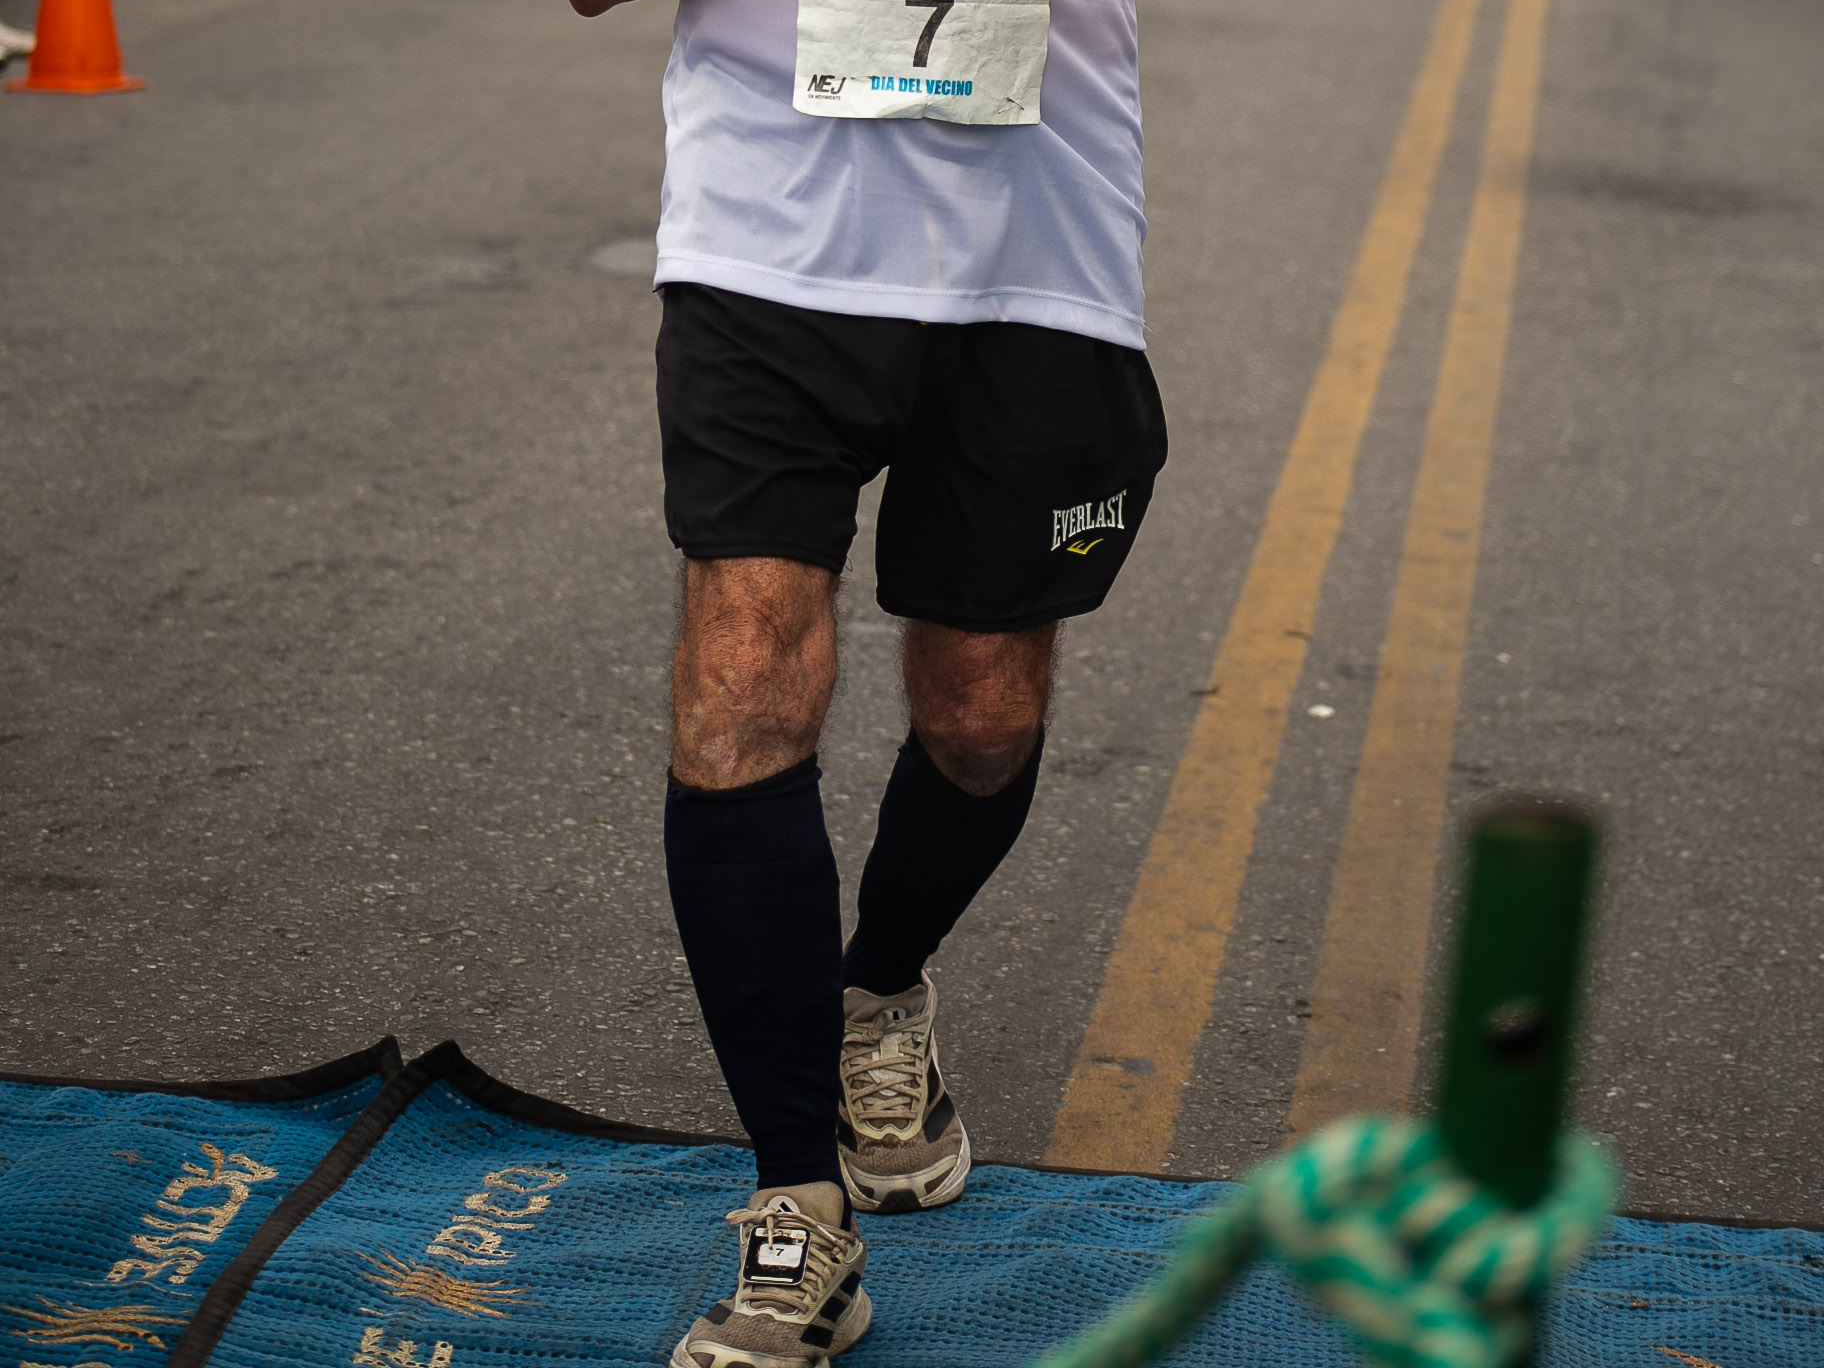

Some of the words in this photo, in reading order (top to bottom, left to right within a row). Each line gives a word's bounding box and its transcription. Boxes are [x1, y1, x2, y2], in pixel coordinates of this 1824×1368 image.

[807, 74, 846, 95] NEJ
[871, 76, 895, 91] DIA
[898, 77, 922, 93] DEL
[925, 79, 973, 96] VECINO
[1051, 489, 1127, 551] EVERLAST
[775, 1247, 785, 1257] 7
